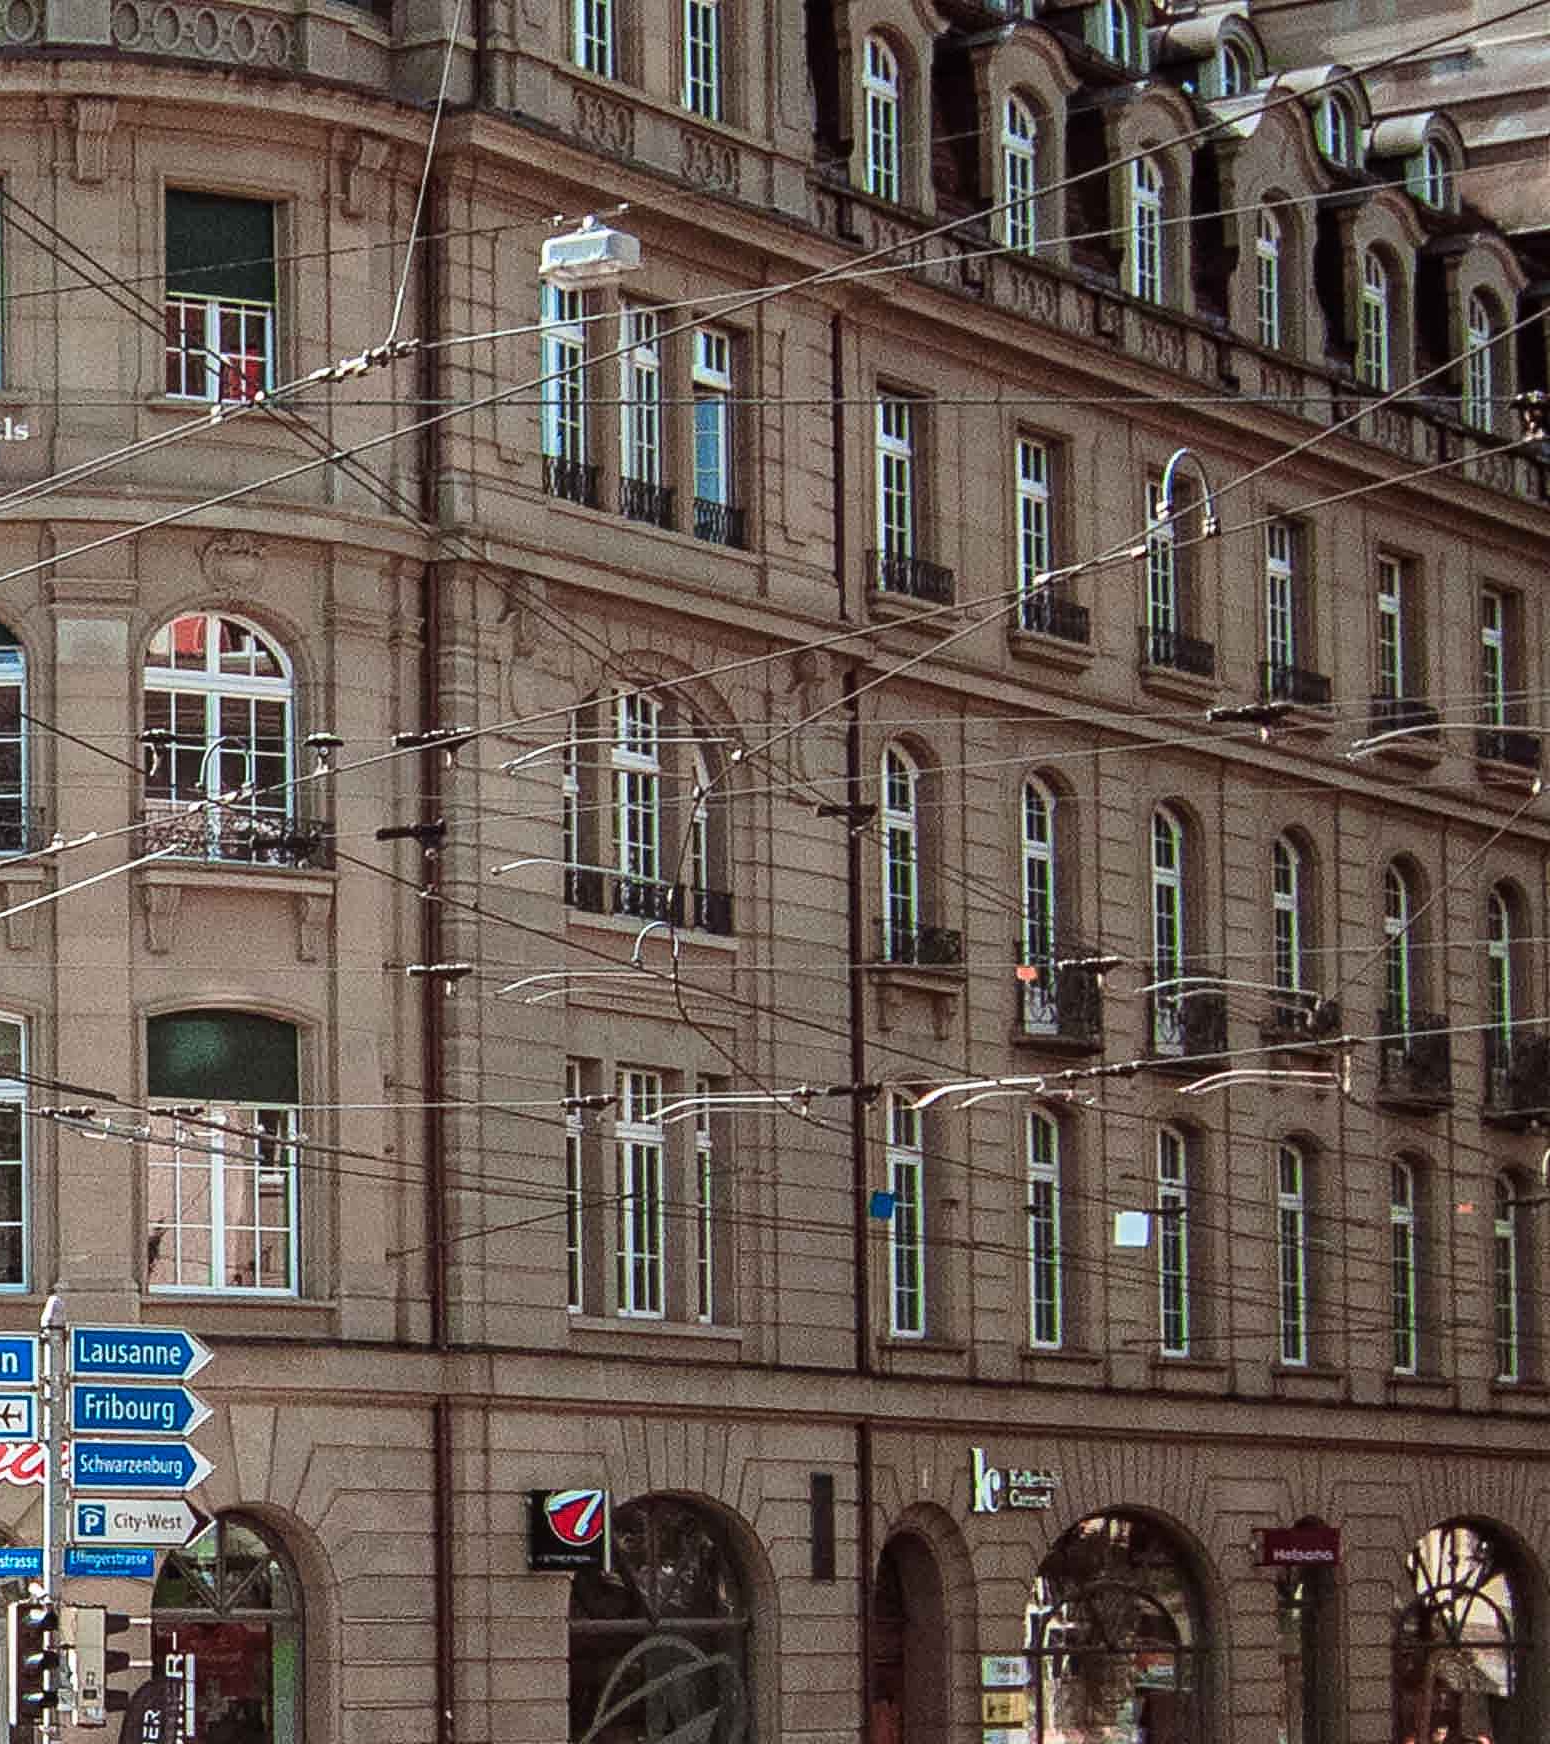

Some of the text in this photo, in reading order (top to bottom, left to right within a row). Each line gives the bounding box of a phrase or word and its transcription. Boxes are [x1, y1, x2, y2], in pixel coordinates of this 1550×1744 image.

[79, 1337, 182, 1365] Lausanne
[85, 1392, 175, 1429] Fribourg
[80, 1454, 183, 1479] Schwarzenburg
[113, 1512, 182, 1531] City-West
